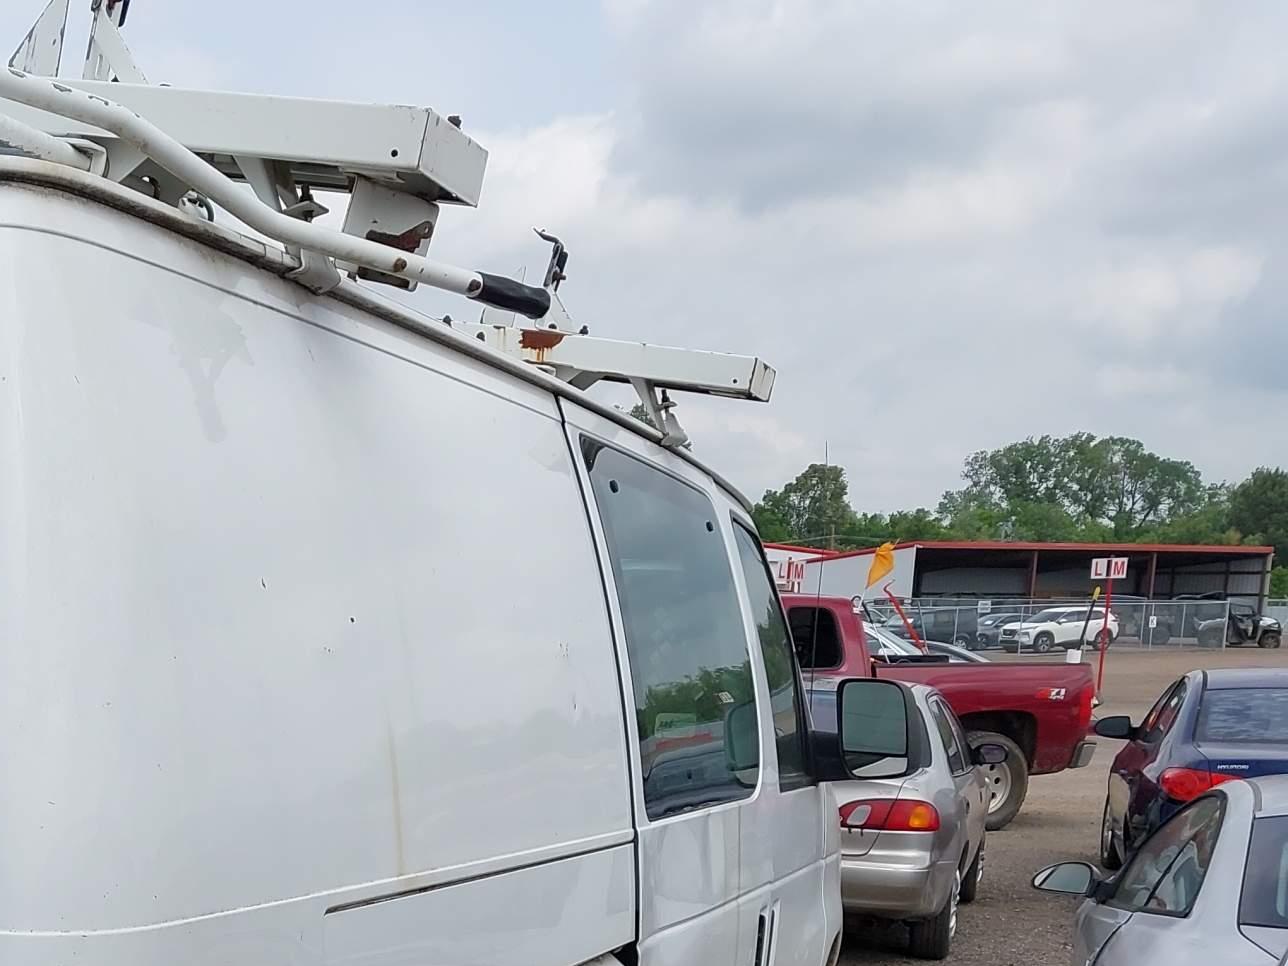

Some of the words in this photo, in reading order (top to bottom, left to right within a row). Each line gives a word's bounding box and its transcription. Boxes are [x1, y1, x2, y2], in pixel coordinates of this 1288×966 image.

[794, 563, 804, 579] M
[1095, 560, 1103, 576] L
[1113, 560, 1126, 576] M
